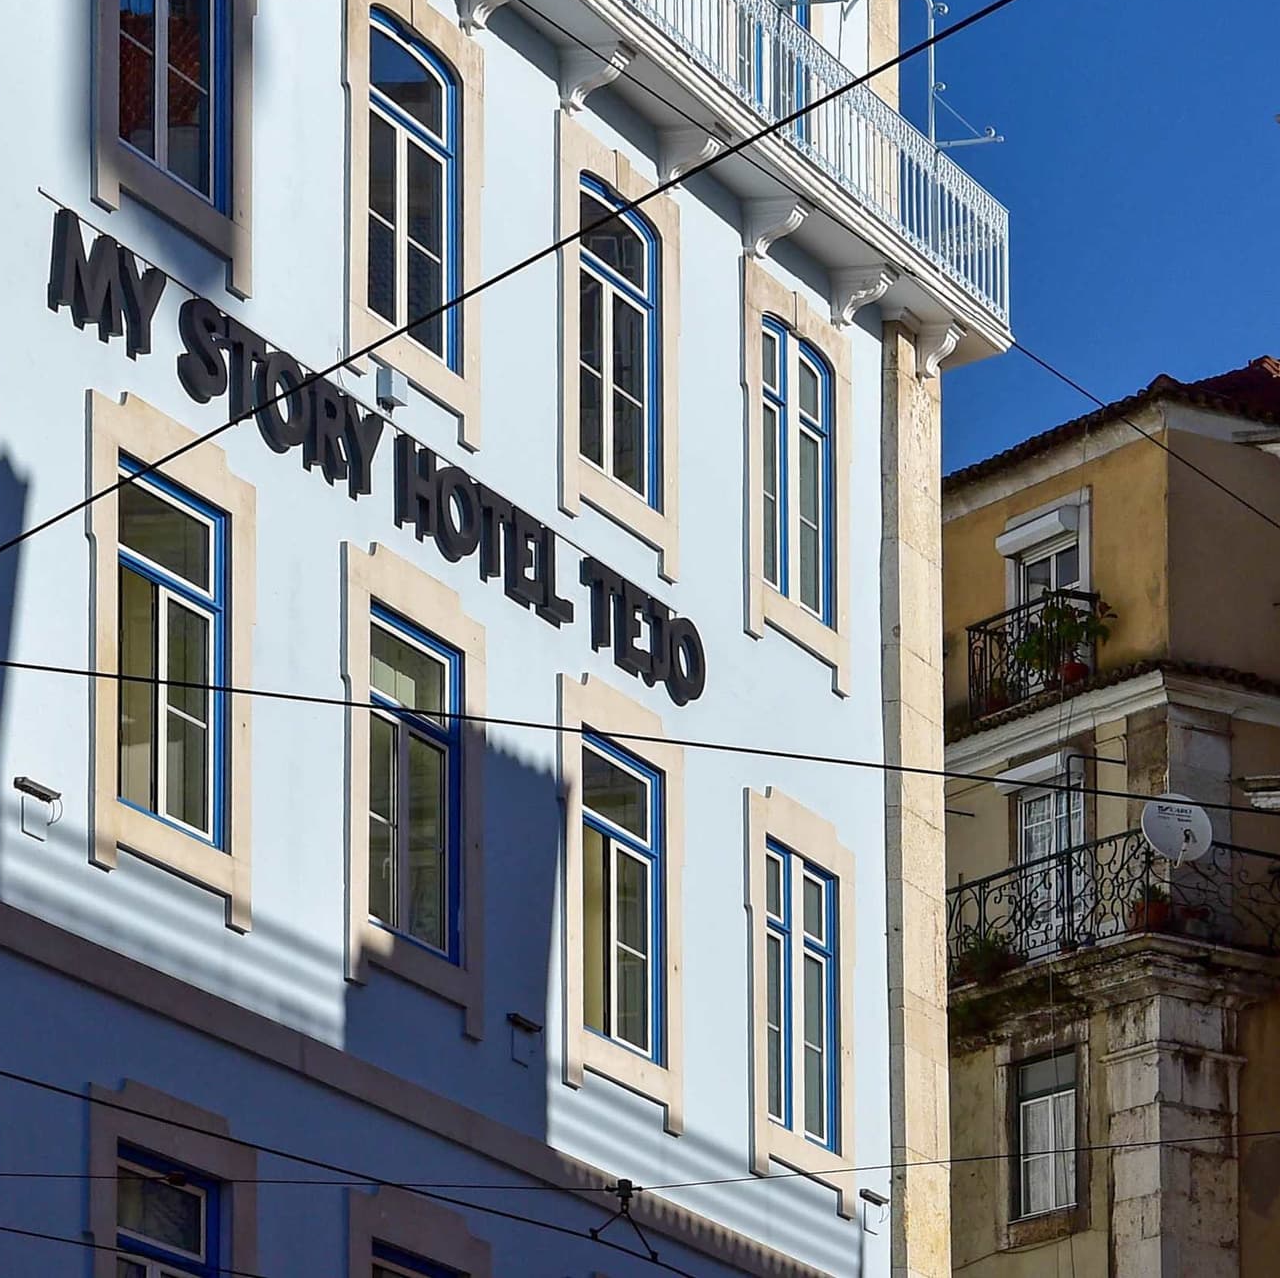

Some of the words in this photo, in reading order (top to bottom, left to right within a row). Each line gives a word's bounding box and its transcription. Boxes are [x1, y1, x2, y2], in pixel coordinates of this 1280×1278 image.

[47, 208, 167, 360] MY
[176, 297, 384, 500] STORY
[394, 431, 573, 628] HOTEL
[579, 556, 706, 706] TEJO
